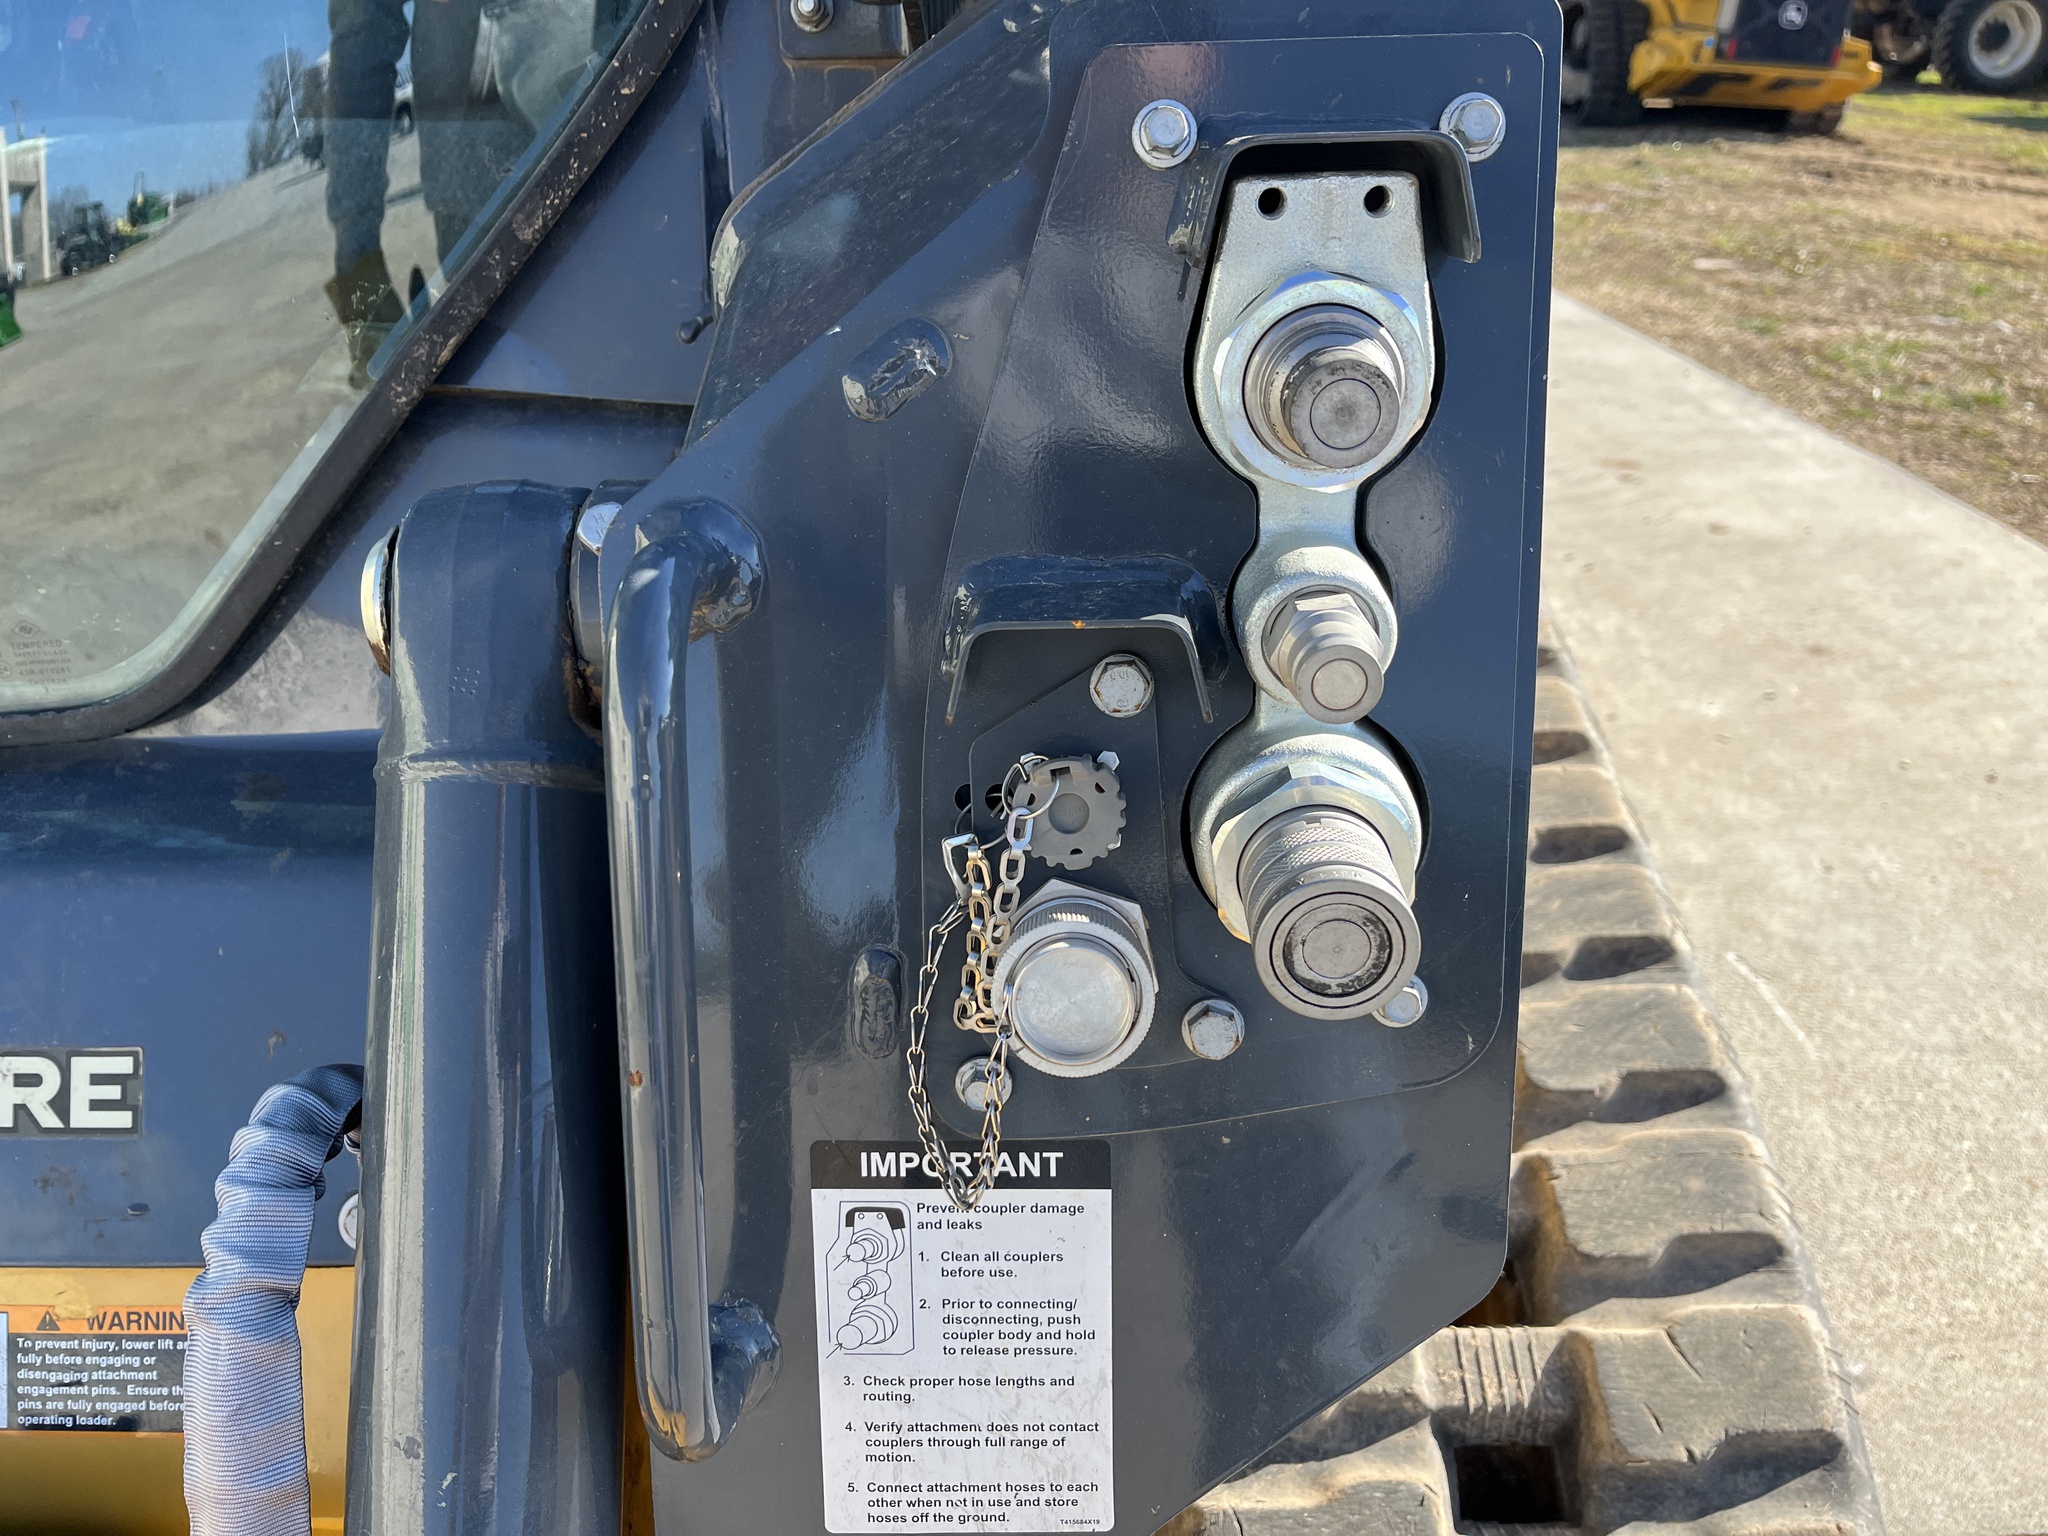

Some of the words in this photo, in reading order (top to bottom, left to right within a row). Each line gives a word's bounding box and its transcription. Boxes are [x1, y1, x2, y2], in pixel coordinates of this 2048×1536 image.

[916, 1202, 971, 1214] Preve
[973, 1202, 1027, 1216] coupler
[1030, 1202, 1085, 1217] damage
[916, 1218, 942, 1230] and
[946, 1218, 983, 1230] leaks
[918, 1250, 930, 1262] 1.
[940, 1250, 980, 1262] Clean
[984, 1250, 1000, 1262] all
[1003, 1251, 1064, 1265] couplers
[941, 1266, 985, 1278] before
[989, 1269, 1018, 1278] use.
[919, 1298, 932, 1309] 2.
[942, 1298, 976, 1309] Prior
[978, 1298, 993, 1309] to
[996, 1298, 1078, 1312] connecting/
[86, 1311, 185, 1331] WARNIN
[942, 1313, 1043, 1327] disconnecting,
[1047, 1313, 1081, 1327] push
[942, 1329, 995, 1343] coupler
[998, 1329, 1032, 1343] body
[1036, 1329, 1062, 1340] and
[1066, 1329, 1096, 1340] hold
[16, 1337, 33, 1348] To
[34, 1339, 80, 1352] prevent
[81, 1338, 120, 1353] injury,
[121, 1338, 156, 1350] lower
[157, 1338, 174, 1350] lift
[942, 1345, 957, 1356] to
[960, 1344, 1009, 1356] release
[1013, 1347, 1078, 1358] pressure.
[16, 1352, 43, 1367] fully
[45, 1353, 83, 1365] before
[85, 1354, 141, 1368] engaging
[142, 1356, 157, 1366] or
[16, 1368, 89, 1384] disengaging
[91, 1369, 158, 1381] attachment
[843, 1375, 855, 1386] 3.
[863, 1375, 906, 1387] Check
[909, 1378, 955, 1389] proper
[958, 1375, 991, 1387] hose
[995, 1375, 1046, 1389] lengths
[1049, 1375, 1075, 1387] and
[16, 1384, 89, 1397] engagement
[91, 1384, 121, 1398] pins.
[126, 1384, 169, 1396] Ensure
[172, 1385, 183, 1396] th
[863, 1390, 916, 1405] routing.
[17, 1398, 43, 1412] pins
[45, 1401, 65, 1410] are
[66, 1399, 93, 1413] fully
[95, 1400, 147, 1413] engaged
[17, 1414, 74, 1428] operating
[75, 1414, 117, 1426] loader.
[844, 1421, 857, 1432] 4.
[864, 1421, 903, 1435] Verify
[907, 1421, 983, 1433] attachment
[986, 1421, 1019, 1432] does
[1023, 1421, 1045, 1432] not
[1048, 1421, 1100, 1432] contact
[865, 1436, 924, 1450] couplers
[927, 1436, 981, 1450] through
[984, 1436, 1006, 1447] full
[1010, 1438, 1048, 1450] range
[1052, 1436, 1067, 1447] of
[865, 1452, 916, 1463] motion.
[847, 1482, 859, 1493] 5.
[867, 1482, 923, 1493] Connect
[926, 1482, 1002, 1493] attachment
[1005, 1481, 1046, 1493] hoses
[1049, 1482, 1063, 1492] to
[1066, 1481, 1099, 1492] each
[867, 1497, 903, 1508] other
[905, 1497, 942, 1508] when
[946, 1497, 968, 1508] not
[971, 1496, 984, 1508] in
[987, 1498, 1012, 1507] use
[1015, 1496, 1040, 1507] and
[1044, 1496, 1079, 1507] store
[867, 1512, 908, 1523] hoses
[911, 1512, 930, 1523] off
[932, 1512, 954, 1523] the
[958, 1511, 1011, 1525] ground.
